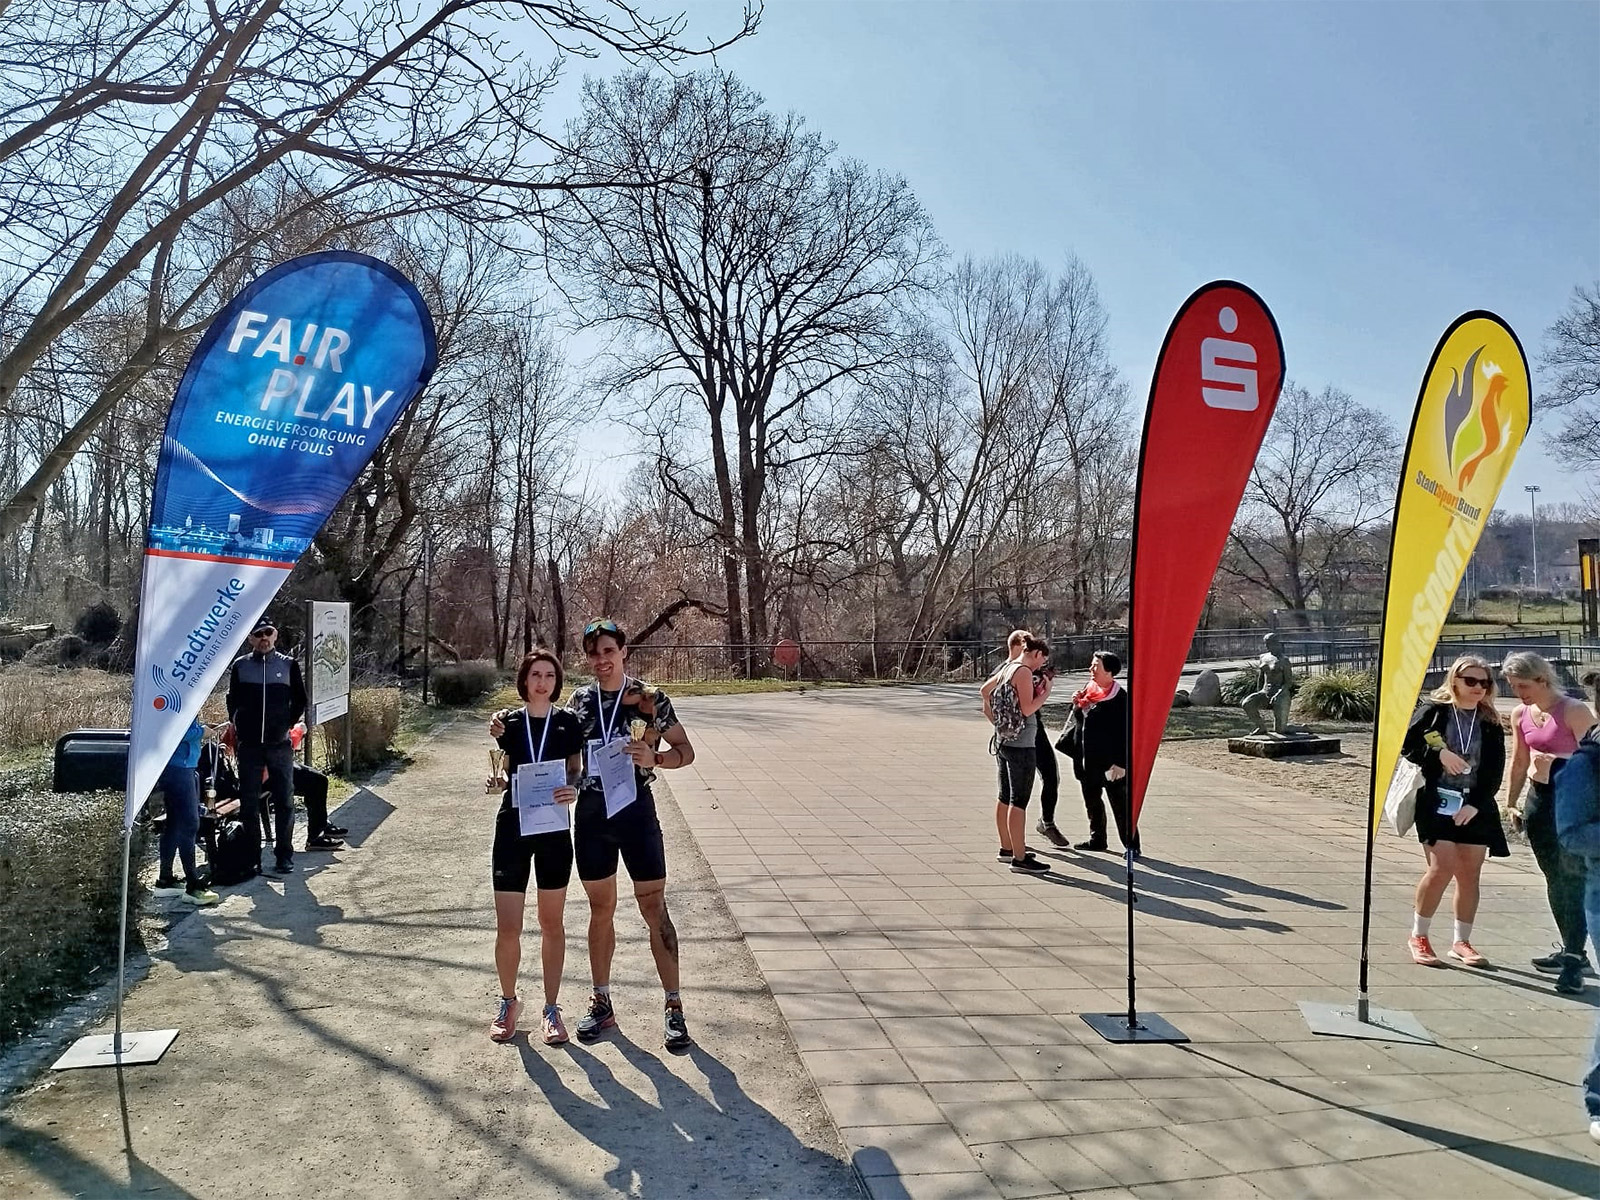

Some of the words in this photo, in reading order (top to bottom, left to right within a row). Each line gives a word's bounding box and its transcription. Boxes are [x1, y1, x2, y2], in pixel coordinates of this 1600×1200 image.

[260, 369, 394, 428] PLAY
[215, 411, 366, 446] ENERGIEVERSORGUNG
[248, 433, 288, 449] OHNE
[291, 440, 334, 456] FOULS
[172, 577, 245, 682] stadtwerke
[188, 638, 224, 688] FRANKFURT
[221, 611, 242, 641] (ODER)
